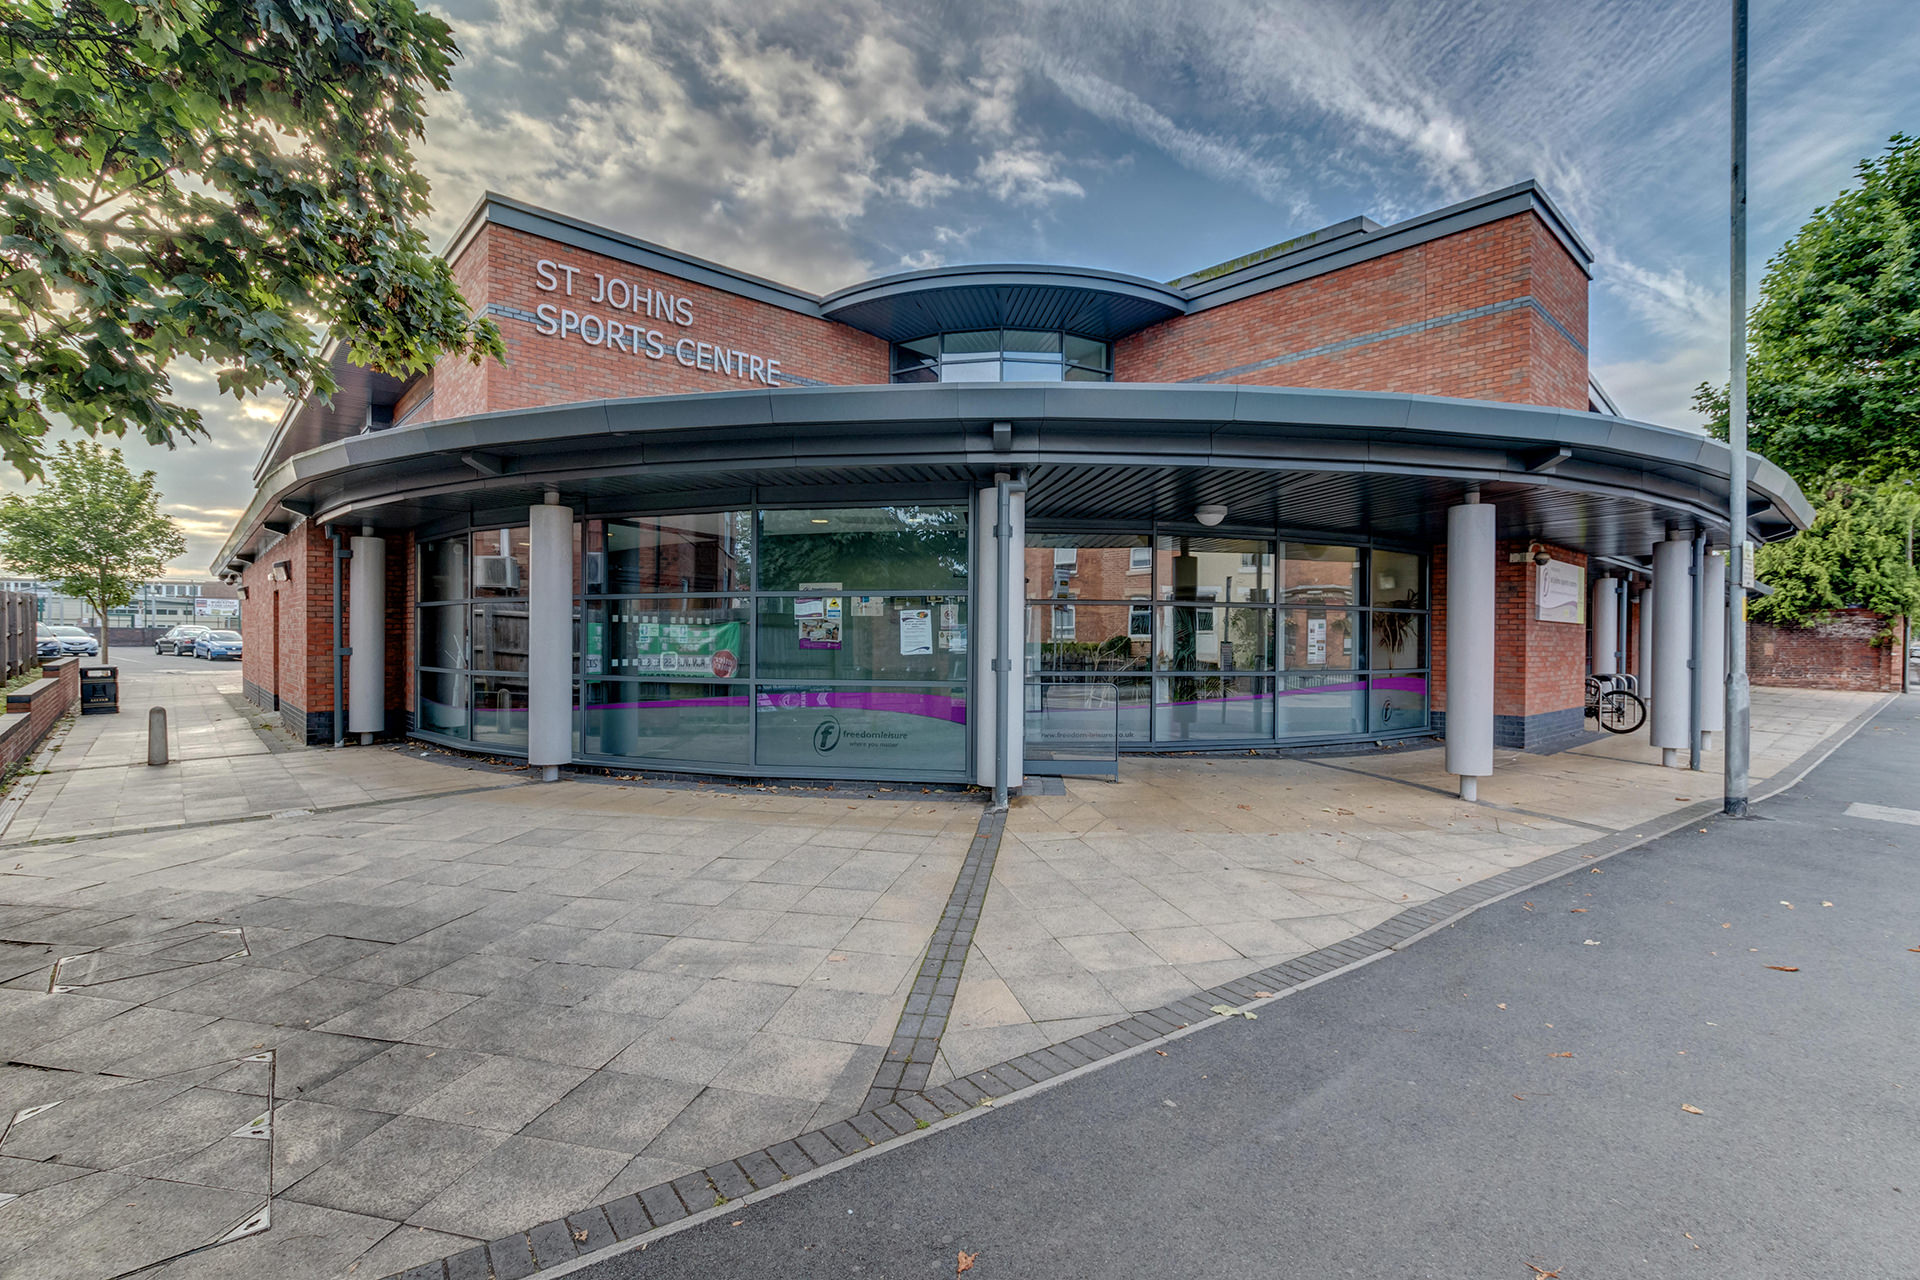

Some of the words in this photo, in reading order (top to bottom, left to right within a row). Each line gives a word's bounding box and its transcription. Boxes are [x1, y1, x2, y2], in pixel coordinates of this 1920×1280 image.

[536, 259, 581, 296] ST
[591, 273, 695, 327] JOHNS
[536, 303, 665, 360] SPORTS
[676, 337, 782, 387] CENTRE
[842, 730, 908, 739] freedomleisure
